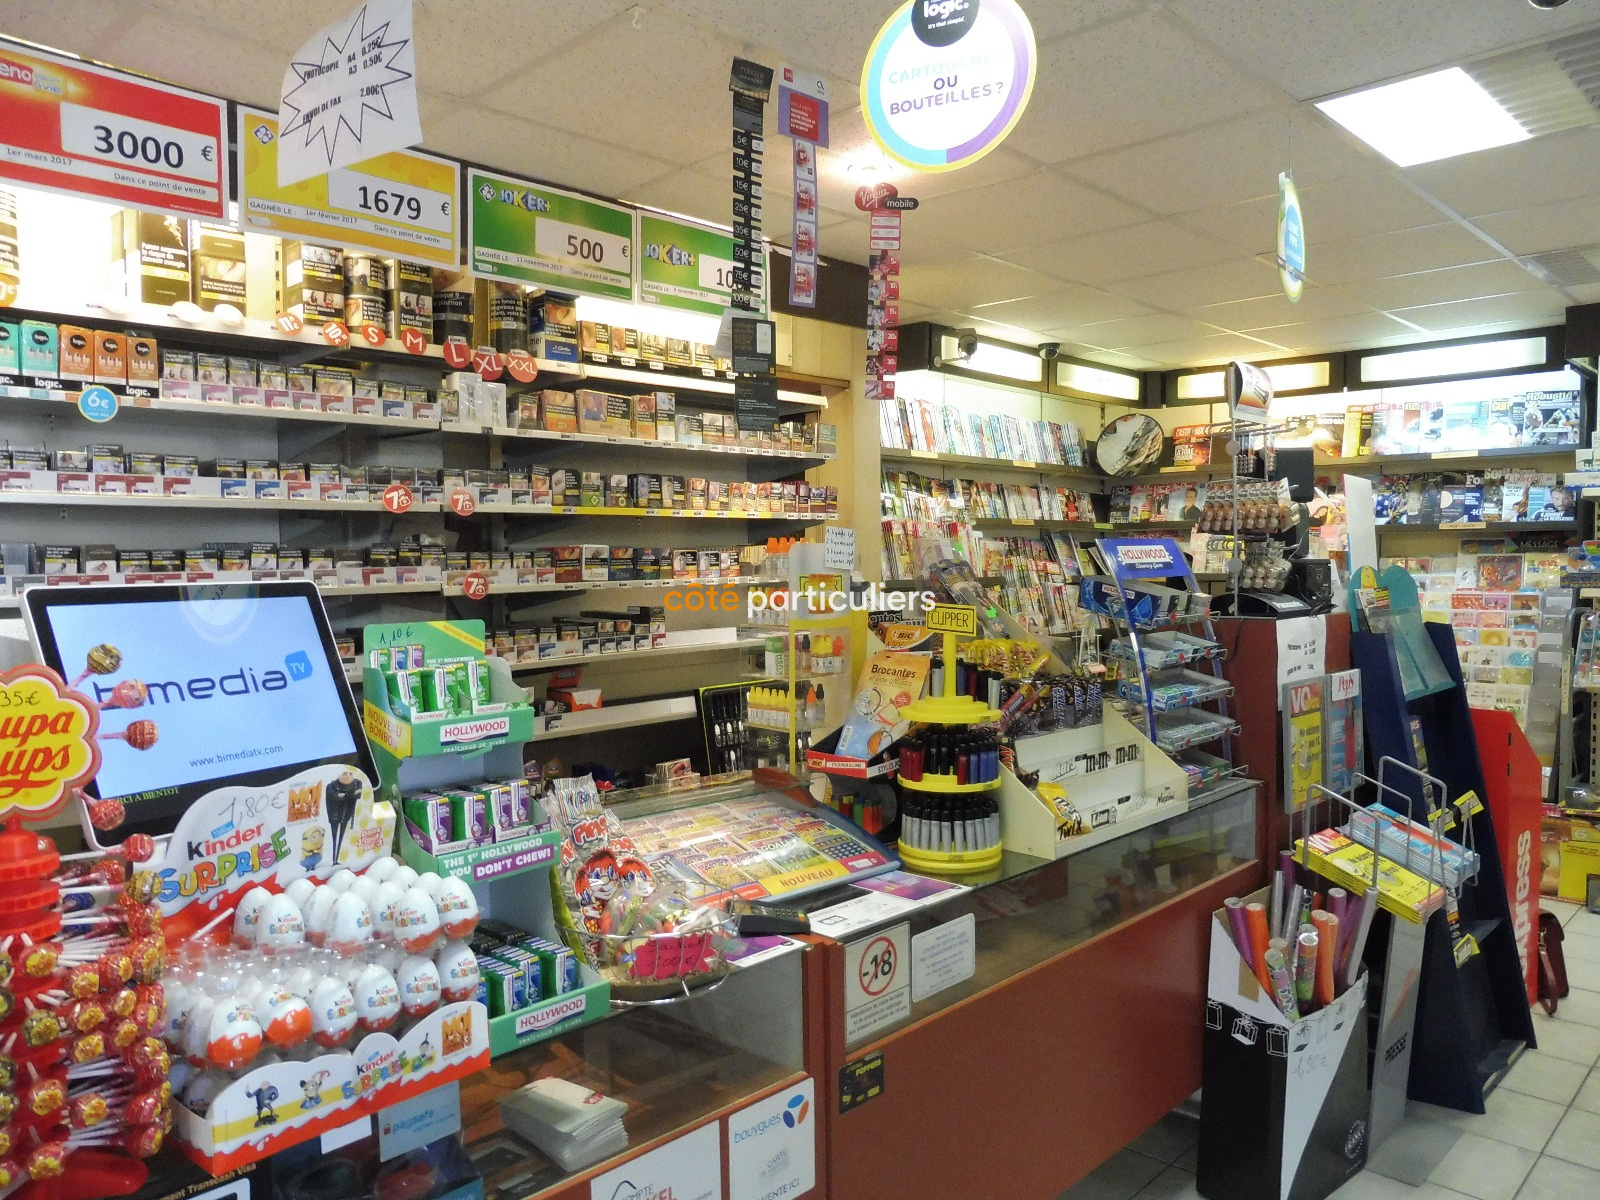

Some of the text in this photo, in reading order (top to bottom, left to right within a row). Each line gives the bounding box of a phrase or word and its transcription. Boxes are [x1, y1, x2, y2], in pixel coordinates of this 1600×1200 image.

[347, 54, 356, 64] A4
[348, 65, 358, 76] A3
[933, 75, 958, 90] OU
[320, 101, 330, 113] DE
[330, 95, 342, 110] FAX
[890, 82, 1004, 115] BOUTEILLES ?
[93, 125, 213, 169] 3000 €
[736, 134, 747, 145] 5€
[25, 153, 47, 162] mars
[51, 156, 72, 166] 2017
[736, 155, 749, 168] 10€
[114, 172, 136, 184] Dans
[149, 179, 170, 191] point
[172, 183, 183, 192] de
[184, 187, 207, 196] vente
[736, 178, 749, 191] 15€
[358, 185, 450, 221] 1679 €
[860, 188, 914, 209] Virgin mobile
[250, 201, 292, 215] GAGNÉS LE
[305, 210, 358, 224] 1er février 2017
[735, 202, 748, 214] 25€
[374, 224, 389, 233] Dans
[399, 229, 415, 240] point
[415, 232, 423, 241] de
[424, 234, 441, 244] vente
[735, 225, 749, 236] 35€
[566, 234, 629, 263] 500 €
[734, 247, 750, 258] 50€
[524, 258, 550, 270] novembre
[589, 271, 602, 282] point
[609, 276, 621, 284] vente
[735, 270, 748, 281] 75€
[368, 328, 378, 343] S
[406, 332, 422, 352] M
[451, 344, 464, 362] L
[476, 356, 502, 372] XL
[508, 357, 537, 375] XXL
[1526, 391, 1573, 401] Acoustic
[1121, 549, 1167, 560] HOLLYWOOD
[931, 610, 969, 628] CLIPPER
[290, 661, 306, 674] TV
[871, 664, 916, 679] Brocantes
[92, 667, 288, 710] bmedia
[0, 711, 75, 748] upa
[368, 708, 402, 737] NOUVEAU
[444, 720, 507, 738] HOLLYWOOD
[0, 744, 71, 785] ups
[189, 744, 283, 768] www.bimediatv.com
[142, 786, 179, 799] BIENTOT
[187, 822, 264, 861] Kinder
[444, 856, 465, 869] THE
[481, 838, 543, 860] HOLLYWOOD
[158, 827, 291, 902] SURPRISE
[450, 848, 551, 878] YOU DON'T CHEW!
[779, 869, 834, 887] NOUVEAU
[863, 950, 893, 980] -18
[520, 998, 584, 1029] HOLLYWOOD
[357, 1050, 394, 1075] Kinder
[342, 1050, 410, 1100] SURPRISE
[734, 1113, 781, 1143] bouygues
[767, 1151, 787, 1168] CARTE
[237, 1163, 257, 1176] Visa
[621, 1184, 654, 1200] OMPTE
[789, 1178, 800, 1190] ICI
